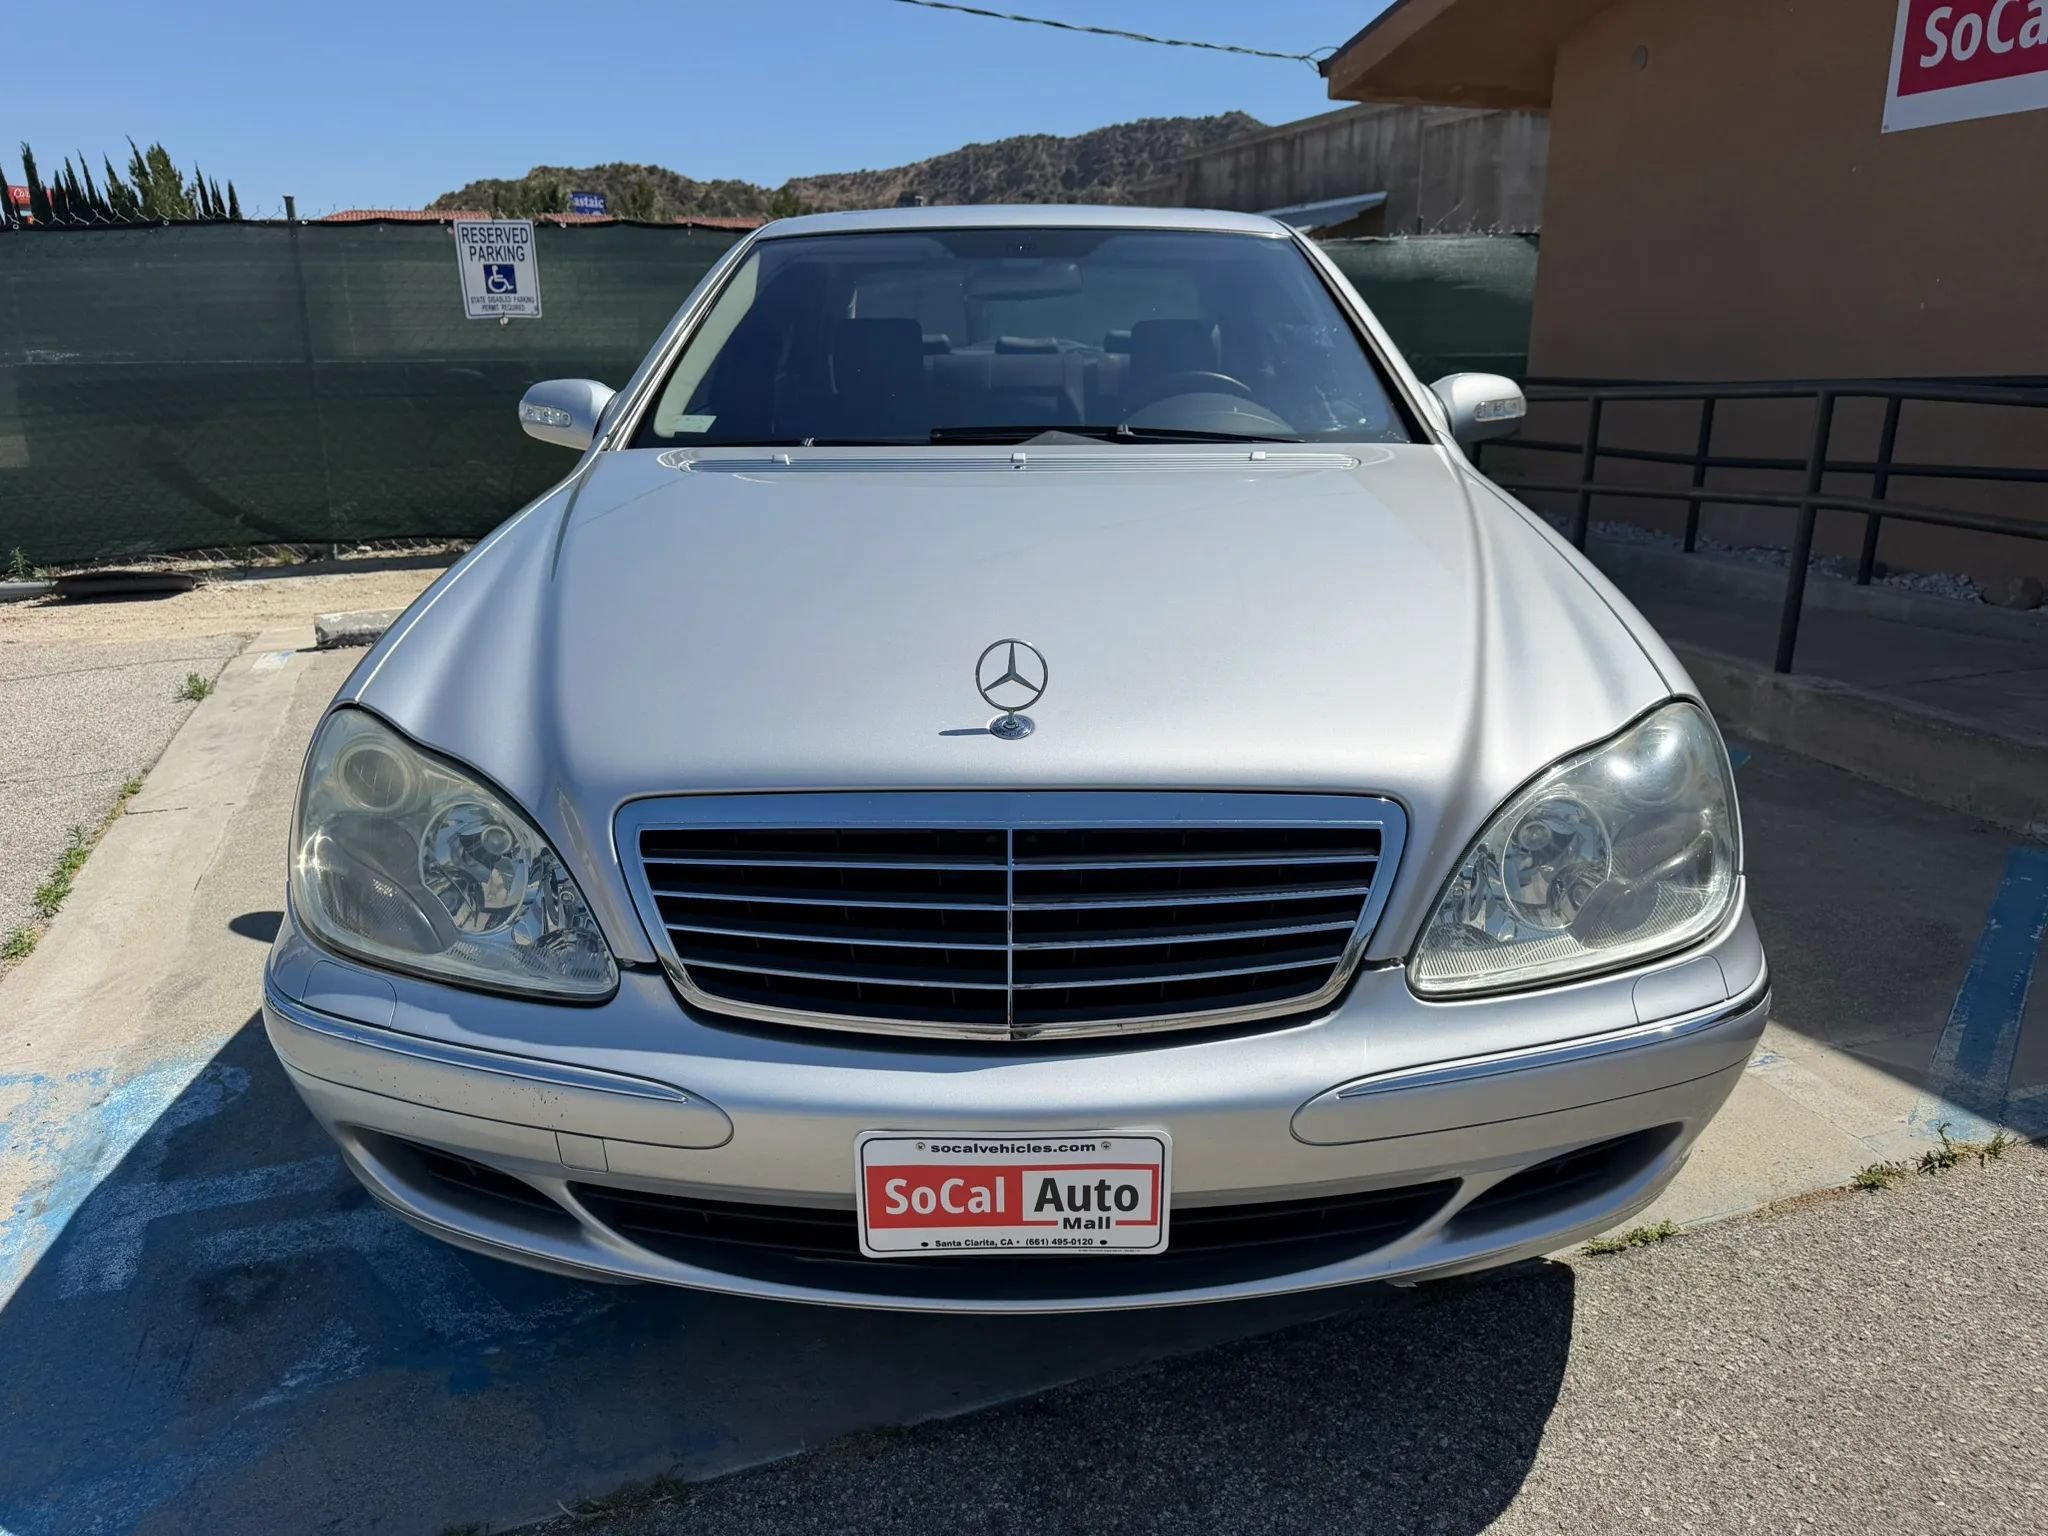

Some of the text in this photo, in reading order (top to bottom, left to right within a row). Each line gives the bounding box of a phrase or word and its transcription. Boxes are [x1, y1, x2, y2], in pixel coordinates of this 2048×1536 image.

[461, 226, 529, 244] RESERVED
[469, 245, 526, 262] PARKING
[470, 295, 535, 304] STATE DISABLED PARKING
[930, 1141, 1096, 1154] socalvehicles.com
[884, 1176, 1140, 1216] SoCal Auto
[1062, 1216, 1111, 1230] Mall
[935, 1239, 962, 1247] Santa
[964, 1239, 998, 1248] Clarita,
[1025, 1238, 1049, 1247] (661)
[1051, 1238, 1094, 1246] 495-0120
